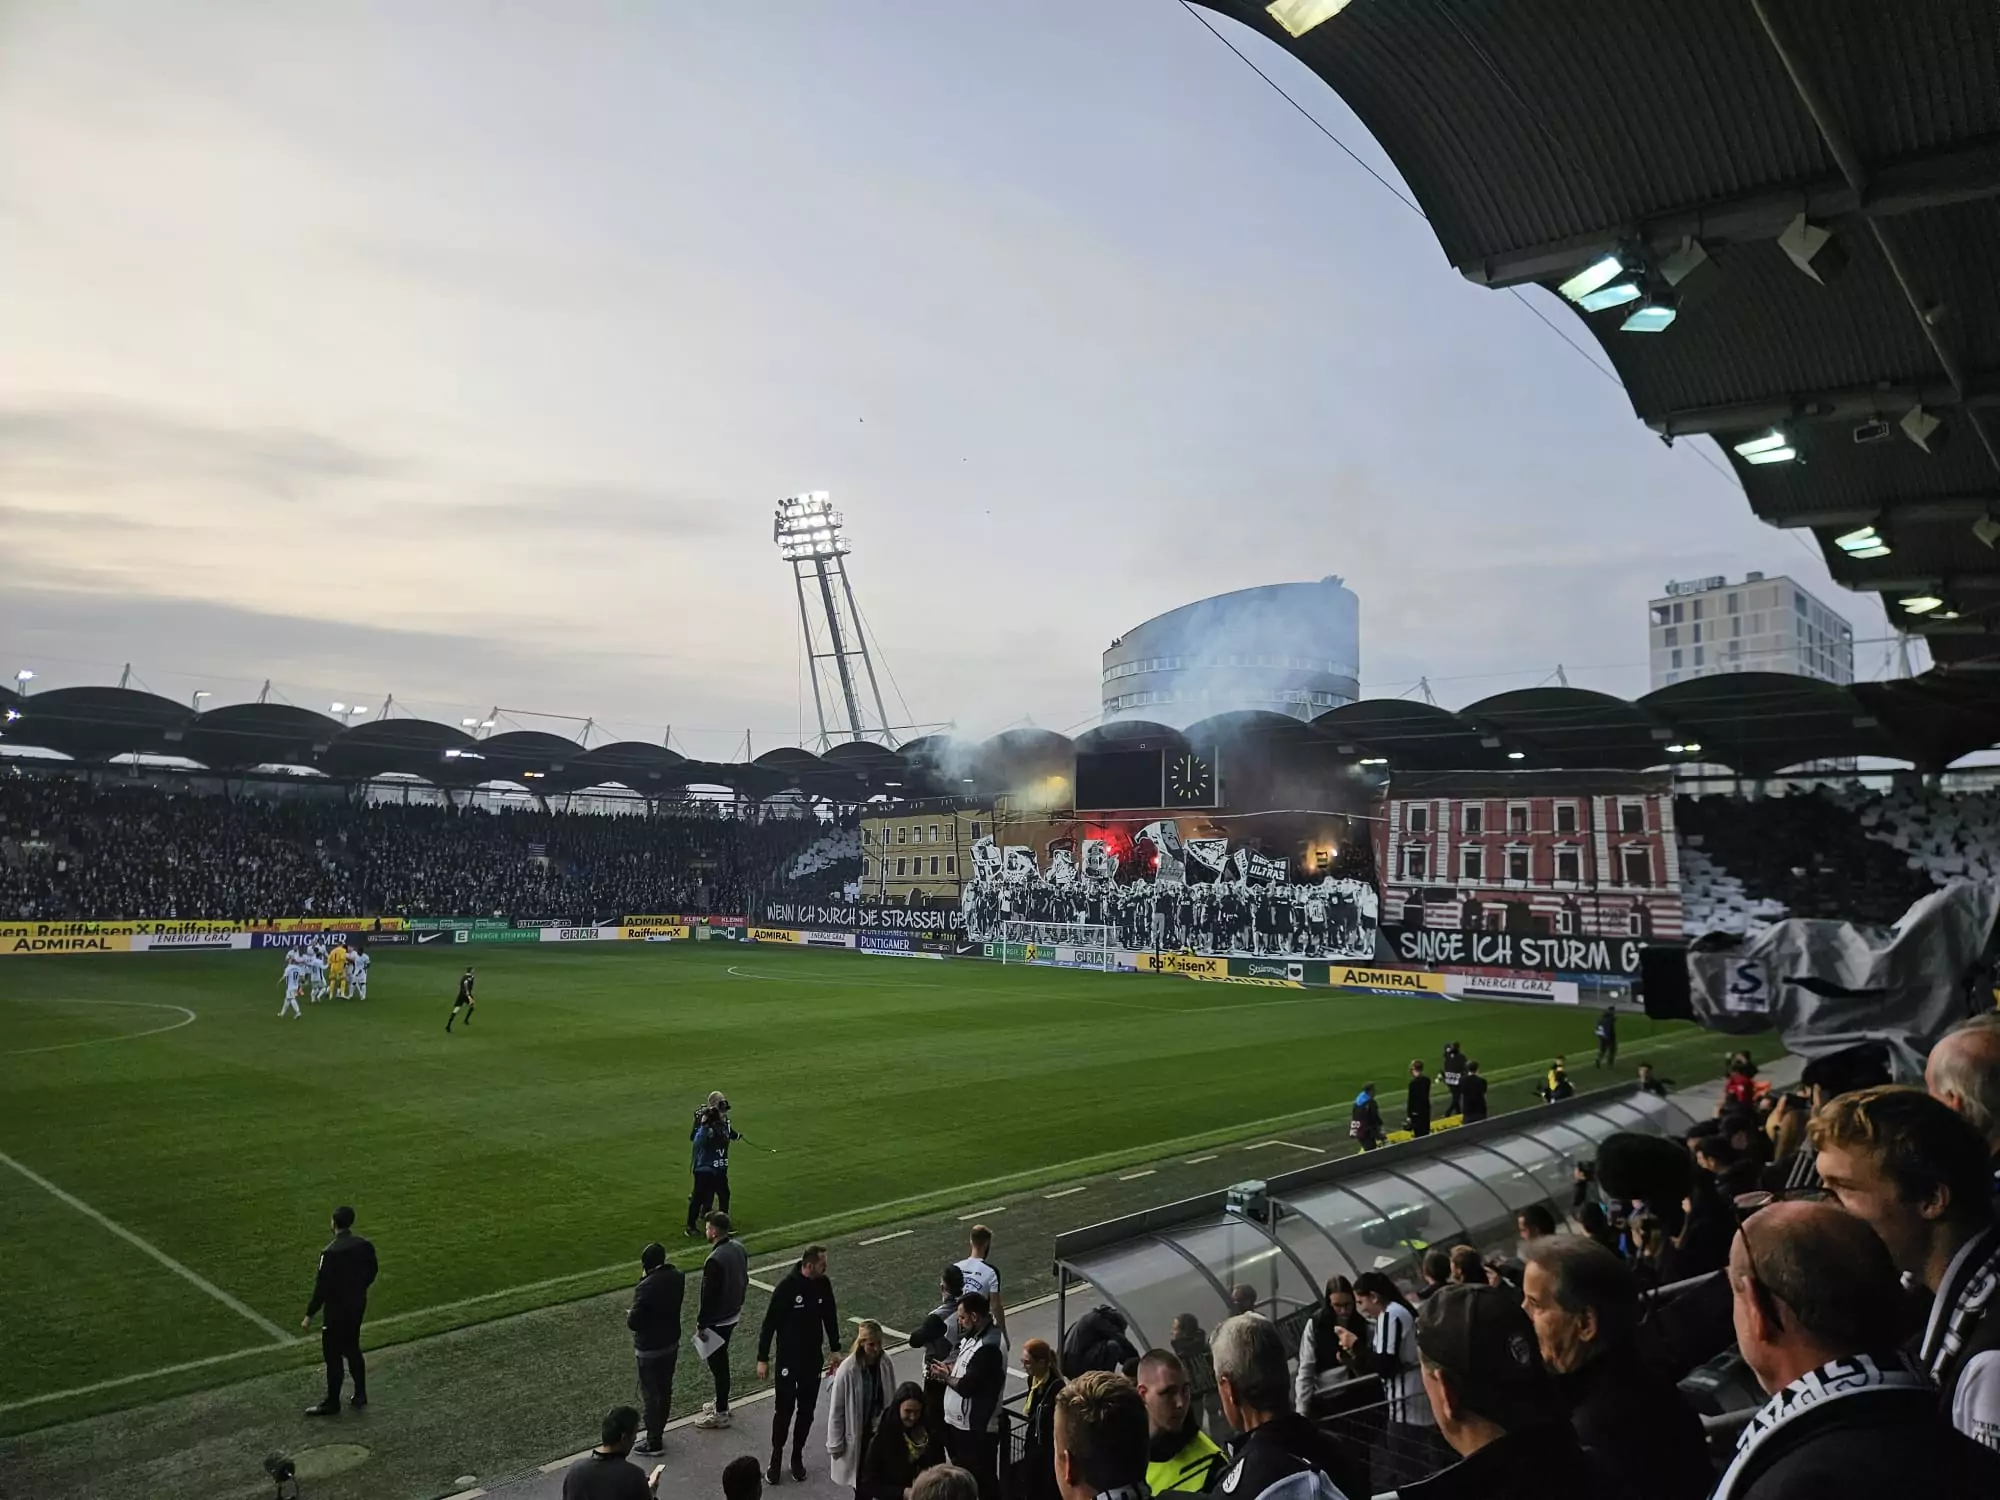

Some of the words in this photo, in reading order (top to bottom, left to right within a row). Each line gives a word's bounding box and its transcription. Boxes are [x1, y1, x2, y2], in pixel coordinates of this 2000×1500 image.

[1250, 865, 1285, 880] ULTRAS
[626, 917, 679, 927] ADMIRAL
[767, 902, 795, 921] WENN
[798, 905, 815, 923] ICH
[818, 907, 856, 925] DURCH
[859, 909, 878, 926] DIE
[881, 910, 945, 929] STRASSEN
[155, 922, 242, 934] Raiffeisen
[560, 929, 599, 940] GRAZ
[157, 934, 201, 943] ENERGIE
[204, 934, 232, 942] GRAZ
[753, 930, 793, 942] ADMIRAL
[861, 936, 910, 950] PUNTIGAMER
[13, 938, 113, 952] ADMIRAL
[1400, 930, 1466, 962] SINGE
[1472, 933, 1513, 965] ICH
[1520, 938, 1611, 970] STURM
[1621, 941, 1647, 973] G
[1074, 951, 1115, 965] GRAZ
[1343, 970, 1428, 989] ADMIRAL
[1471, 976, 1518, 989] ENERGIE
[1522, 980, 1553, 992] GRAZ
[1731, 962, 1763, 994] S
